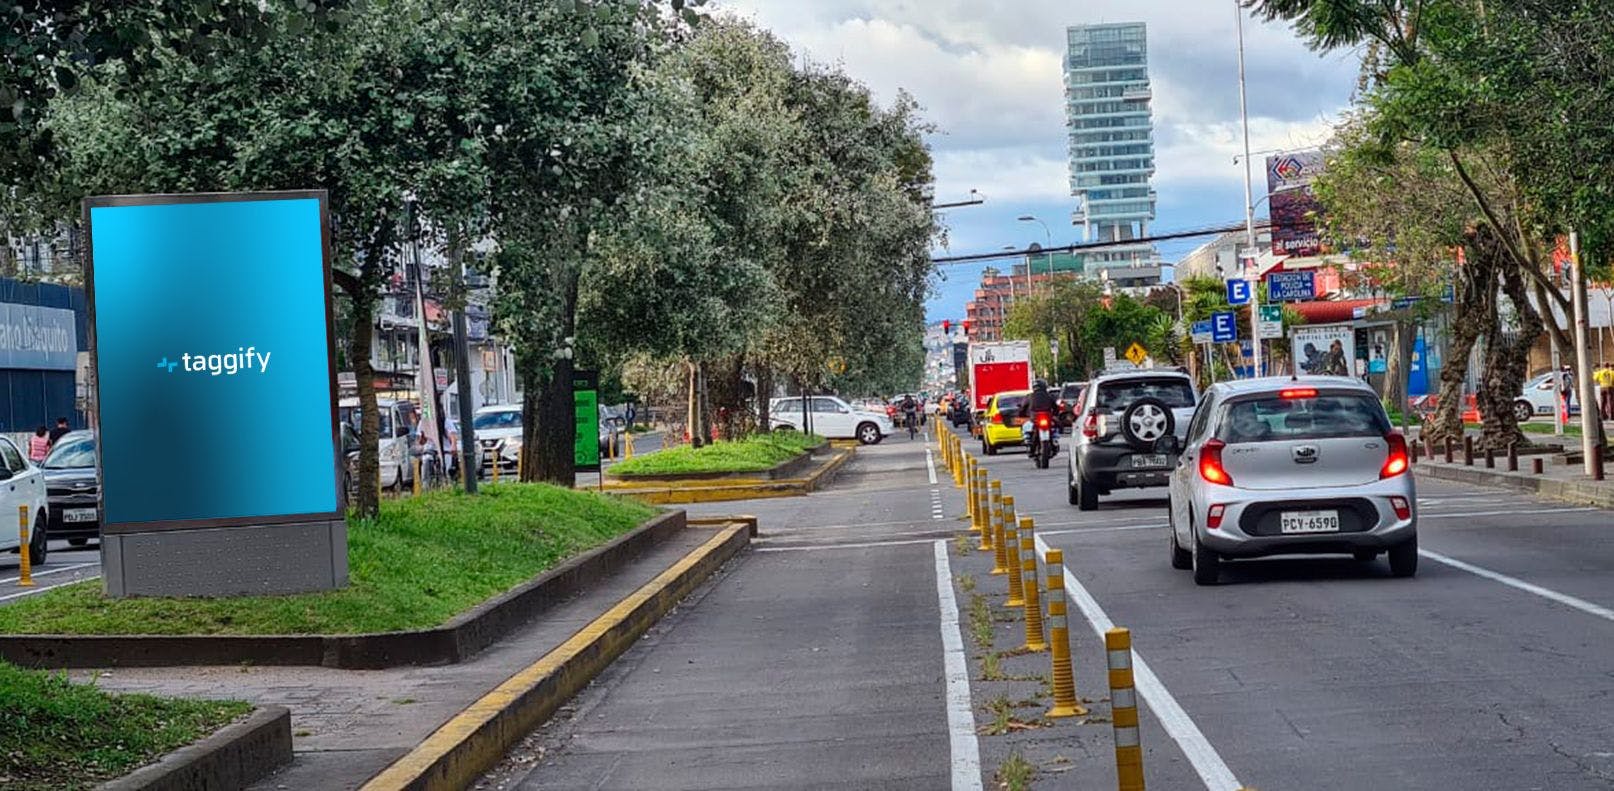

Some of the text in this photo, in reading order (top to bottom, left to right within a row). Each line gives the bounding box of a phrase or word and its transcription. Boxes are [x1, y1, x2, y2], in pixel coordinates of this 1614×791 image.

[1285, 237, 1319, 250] servicio
[1233, 282, 1246, 300] E
[1216, 315, 1231, 332] E
[181, 346, 272, 376] taggify
[1282, 516, 1337, 531] PCY-6590
